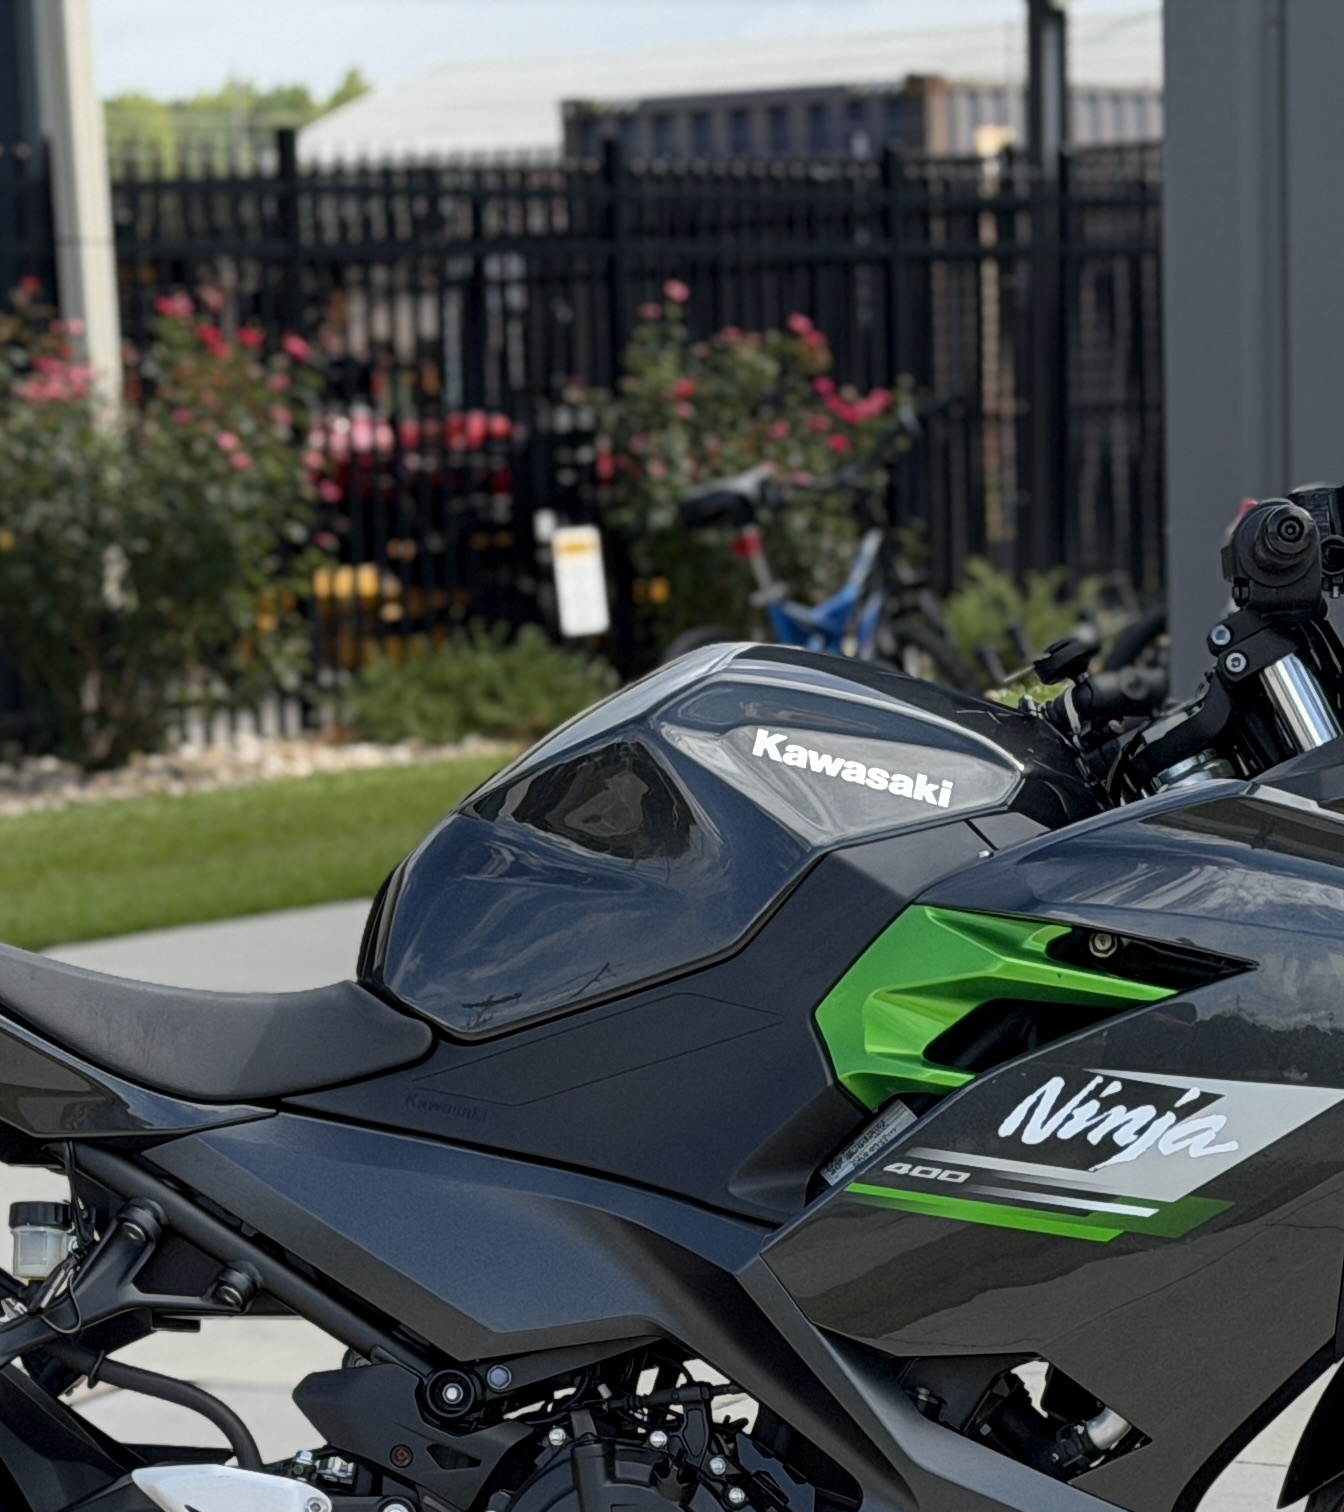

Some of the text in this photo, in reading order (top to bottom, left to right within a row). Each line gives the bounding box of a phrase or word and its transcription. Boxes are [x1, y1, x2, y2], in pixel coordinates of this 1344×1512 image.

[752, 728, 954, 808] Kawasaki
[997, 1076, 1239, 1173] Ninja
[882, 1162, 971, 1184] 400
